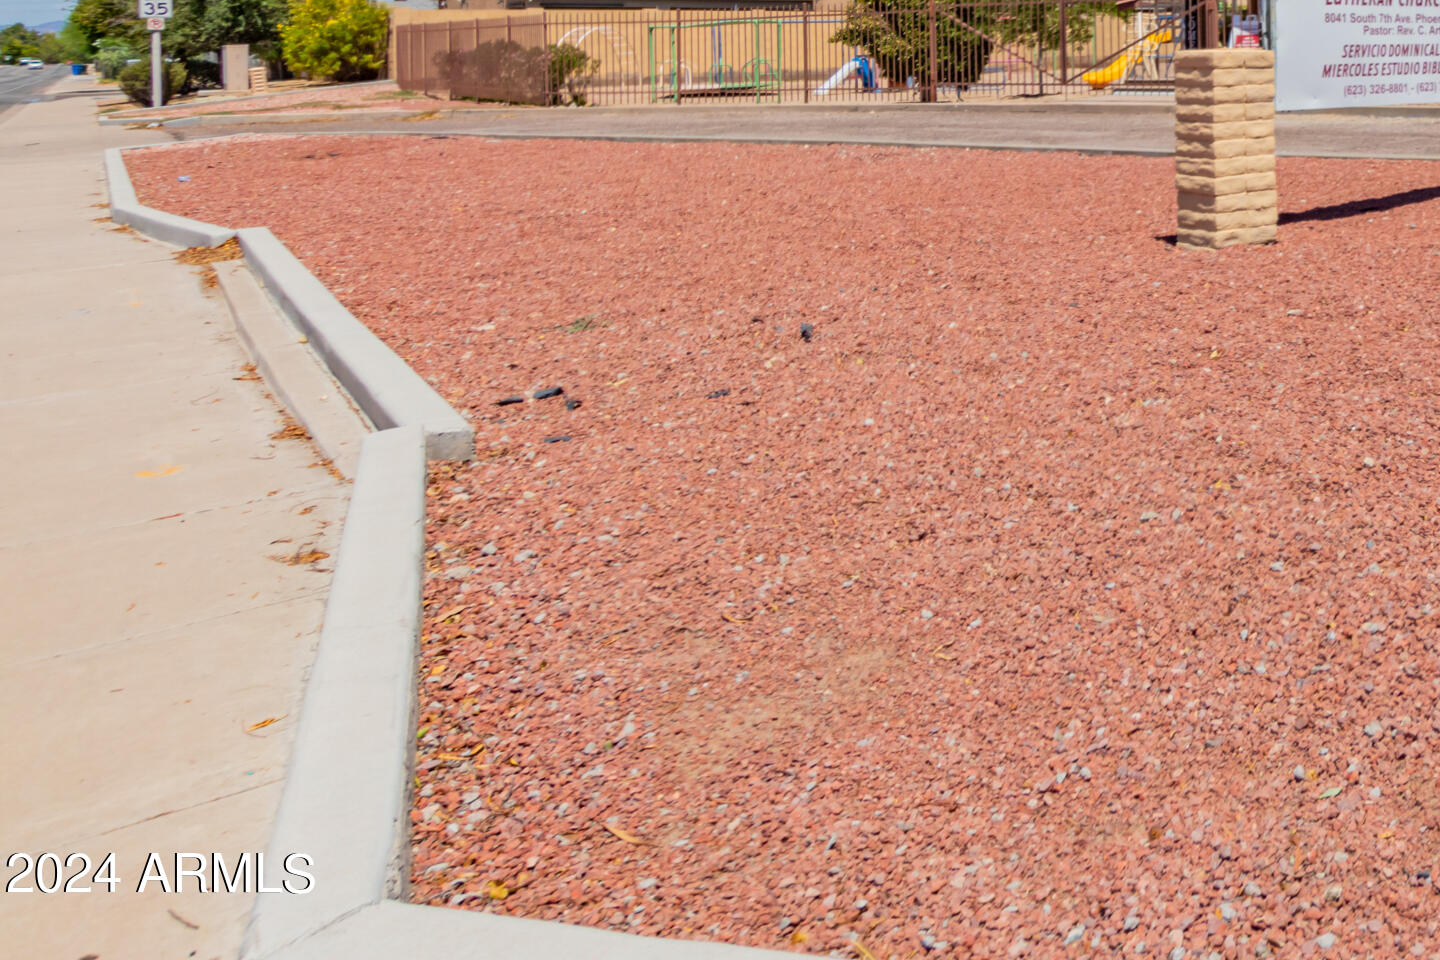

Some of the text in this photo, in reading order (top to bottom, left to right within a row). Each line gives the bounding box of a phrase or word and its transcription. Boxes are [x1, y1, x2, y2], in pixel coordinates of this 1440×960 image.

[144, 2, 168, 15] 35
[1324, 13, 1347, 23] 8041
[1349, 13, 1377, 23] South
[1379, 13, 1392, 24] 7th
[1363, 26, 1395, 36] Pastor:
[1397, 26, 1415, 36] Rev.
[1342, 44, 1386, 58] SERVICIO
[1388, 44, 1440, 58] DOMINICAL
[1322, 63, 1380, 78] MIERCOLES
[1381, 62, 1420, 76] ESTUDIO
[1343, 85, 1367, 97] (623)
[1416, 82, 1437, 95] (623)
